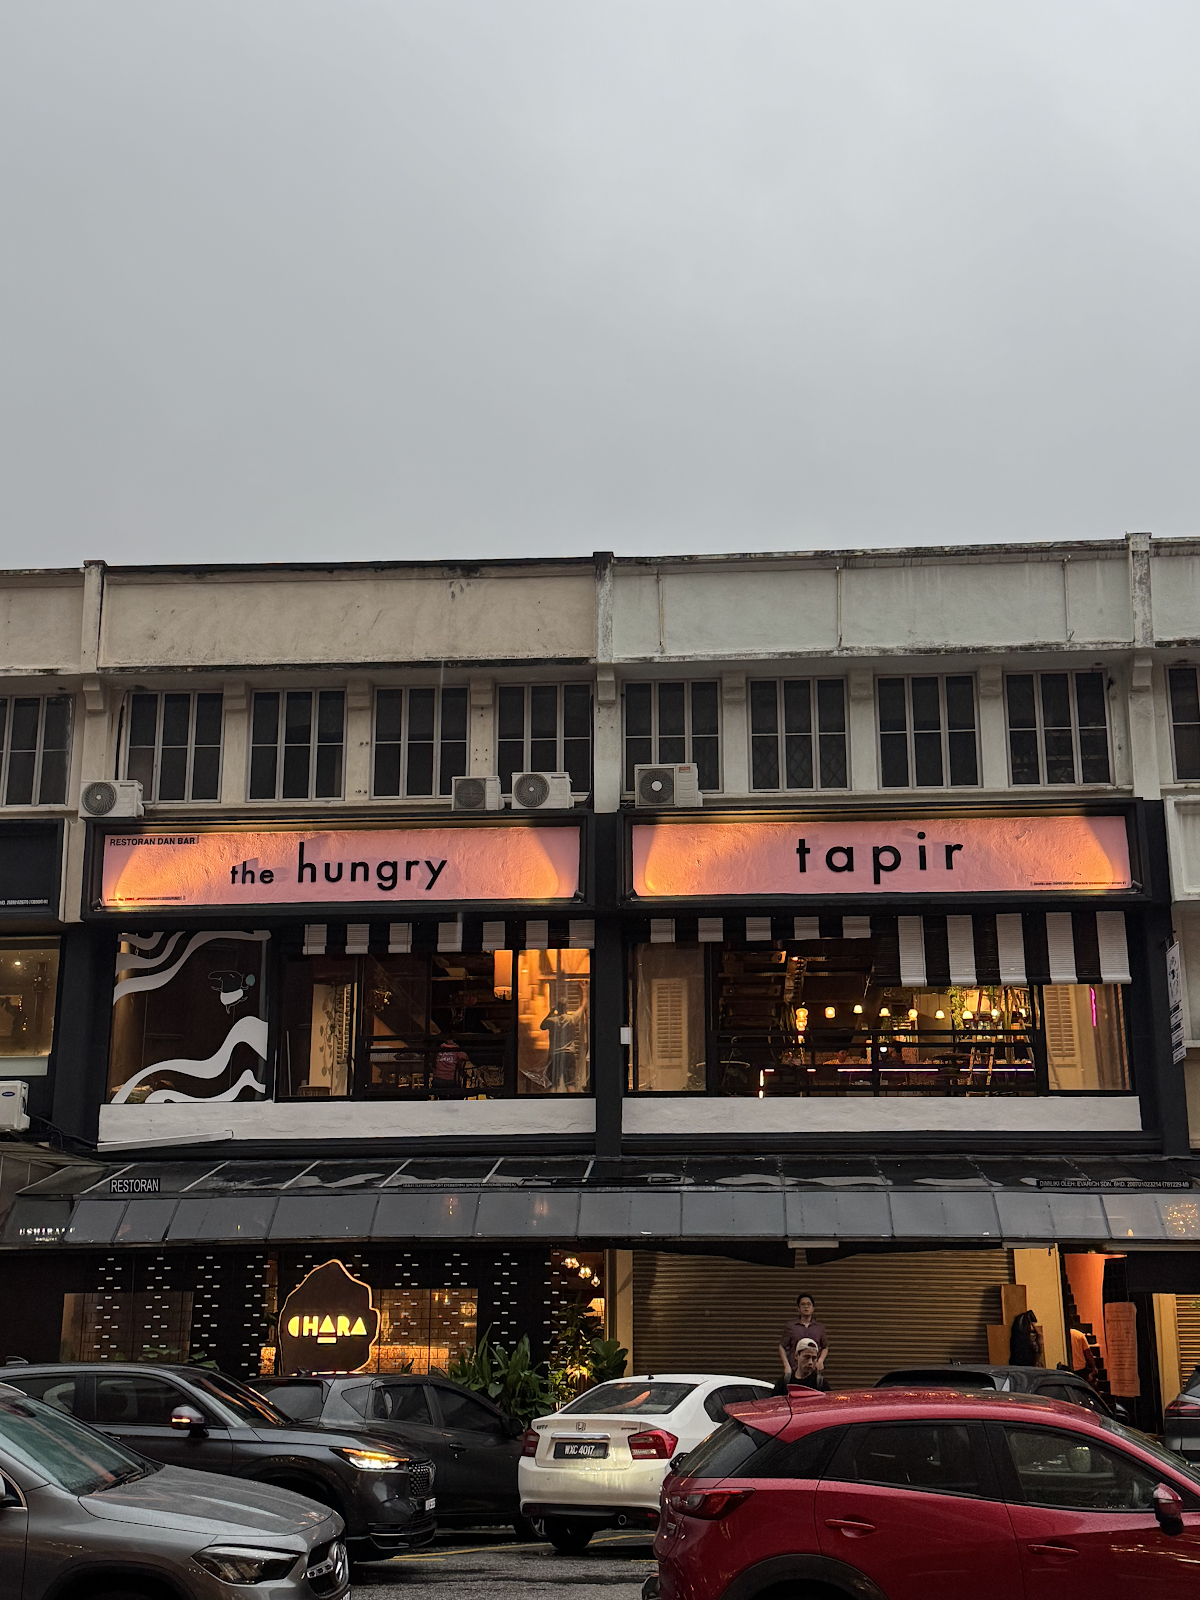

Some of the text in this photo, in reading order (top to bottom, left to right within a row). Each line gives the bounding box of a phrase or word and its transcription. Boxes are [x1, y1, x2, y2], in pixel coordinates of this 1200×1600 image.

[109, 838, 156, 846] RESTORAN
[177, 837, 195, 845] BAR
[796, 831, 964, 885] tapir
[230, 841, 448, 891] the hungry
[110, 1178, 159, 1193] RESTORAN
[564, 1444, 596, 1456] WXC 4017
